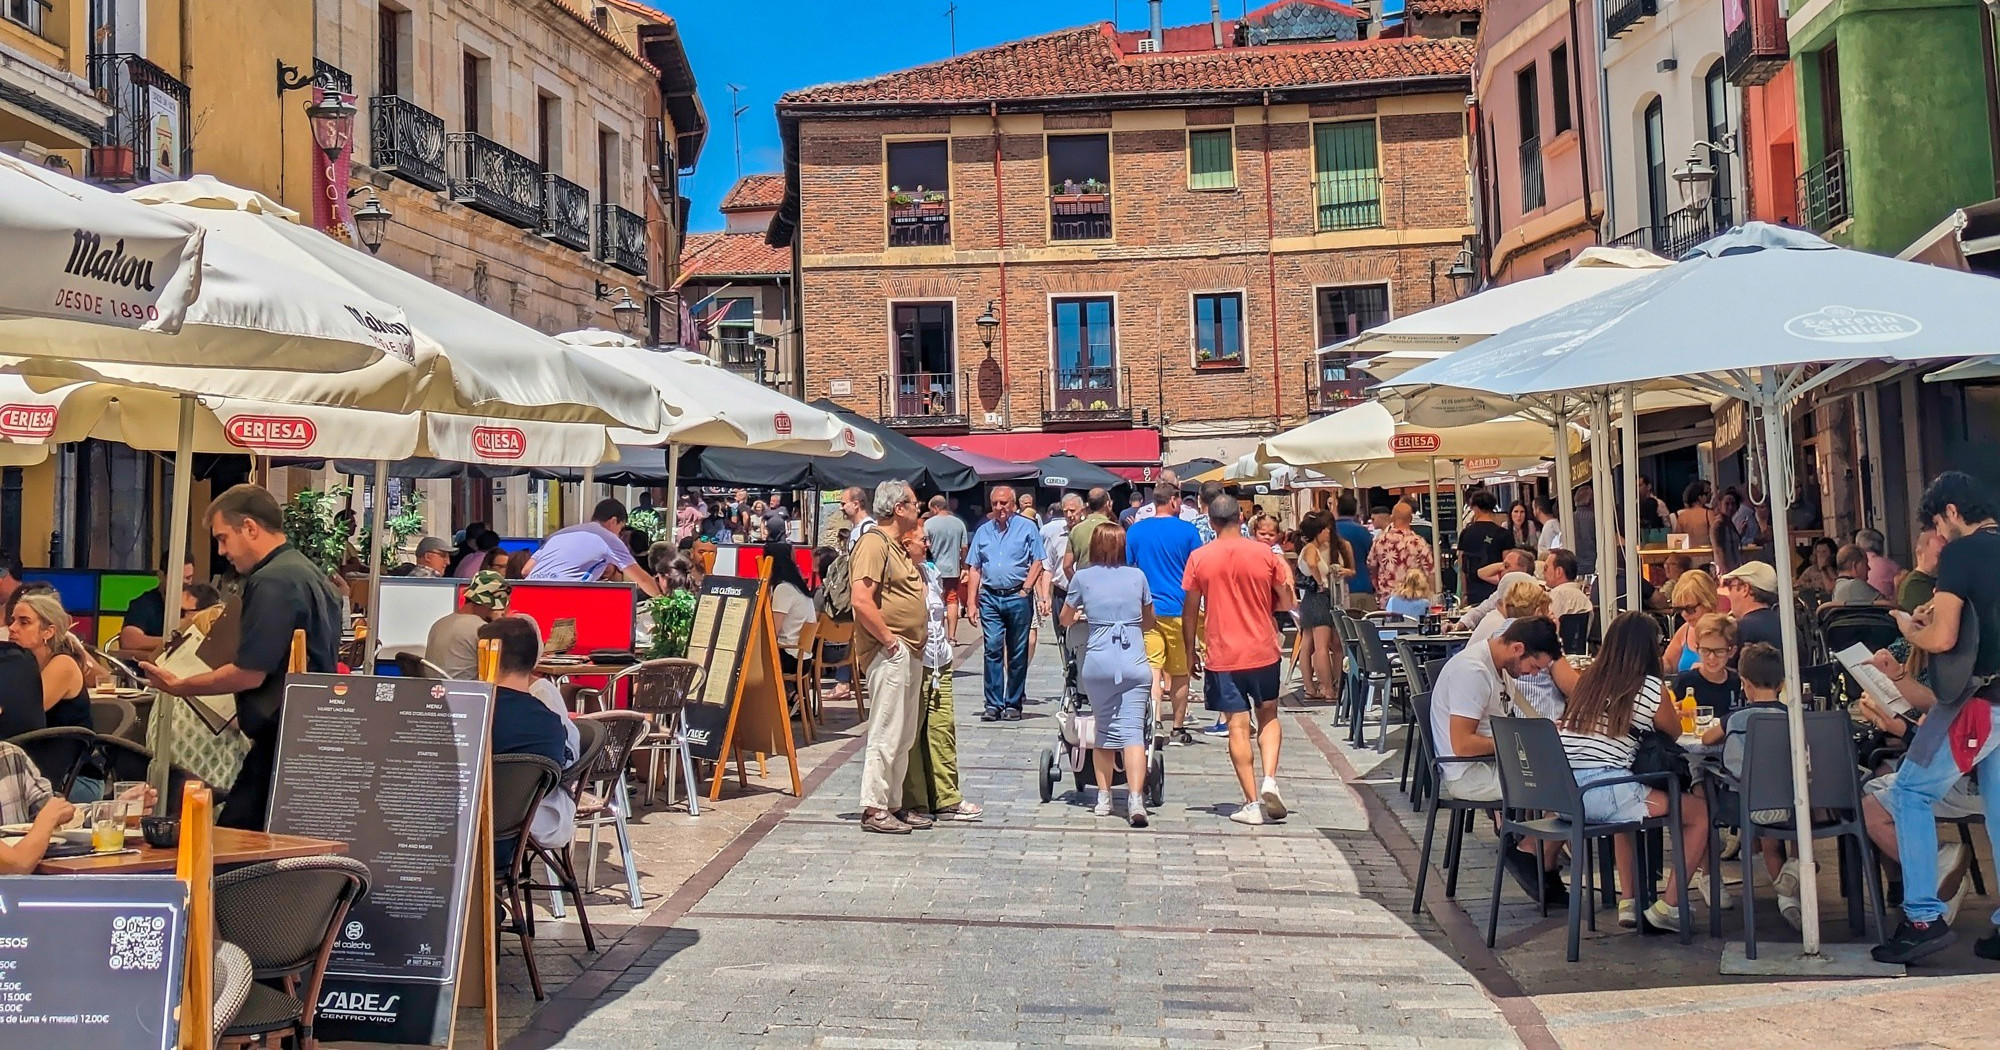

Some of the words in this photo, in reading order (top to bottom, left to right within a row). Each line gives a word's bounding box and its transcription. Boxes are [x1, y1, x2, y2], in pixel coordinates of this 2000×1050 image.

[64, 228, 155, 292] Mahou
[55, 289, 102, 315] DESDE
[110, 300, 159, 321] 1890
[0, 410, 54, 436] CERLESA
[230, 421, 307, 443] CERLESA
[475, 432, 520, 453] CERLESA
[1391, 436, 1435, 449] CERLESA
[333, 940, 341, 948] el
[318, 991, 400, 1011] SARES
[6, 1014, 18, 1023] de
[19, 1014, 40, 1023] Luna
[41, 1014, 47, 1023] 4
[48, 1014, 78, 1024] meses)
[320, 1013, 367, 1021] CENTRO
[368, 1015, 396, 1023] VINO
